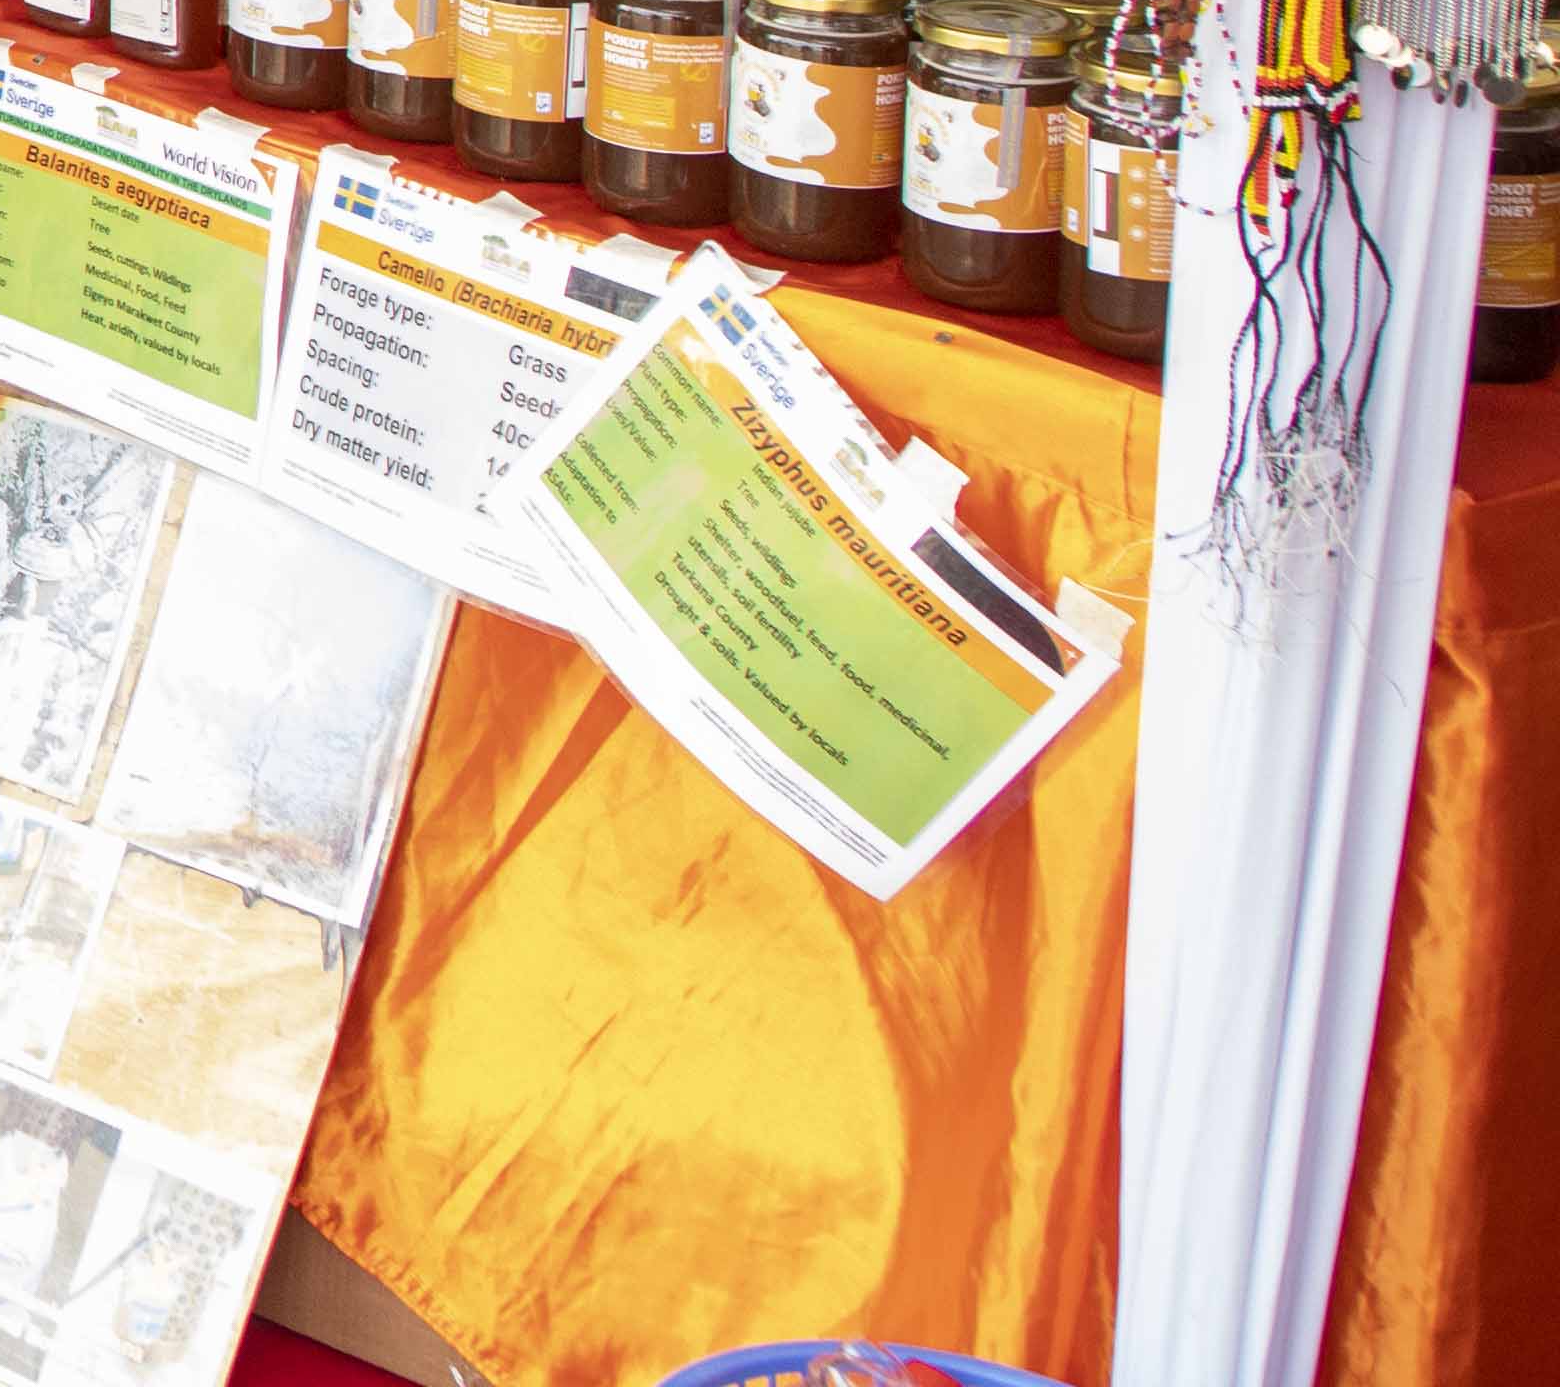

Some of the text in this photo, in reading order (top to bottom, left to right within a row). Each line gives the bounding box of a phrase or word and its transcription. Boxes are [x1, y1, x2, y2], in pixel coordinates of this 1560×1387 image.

[5, 87, 55, 118] Sverige
[25, 144, 212, 229] Balanites aegyptiaca
[163, 142, 259, 193] World Vision
[1488, 182, 1534, 197] OKOT
[88, 218, 111, 236] Tree
[377, 208, 435, 244] Sverige
[1487, 204, 1537, 219] ONEY
[163, 295, 187, 315] Feed
[320, 267, 567, 383] Forage type: Grass
[377, 250, 616, 358] Camello (Brachiaria hybri
[142, 334, 175, 358] valued
[175, 347, 190, 365] by
[191, 354, 222, 376] locals
[164, 320, 201, 345] County
[312, 302, 431, 369] Propagation:
[306, 338, 380, 388] Spacing:
[740, 342, 796, 410] Sverige
[299, 375, 426, 447] Crude protein:
[292, 409, 321, 442] Dry
[326, 427, 381, 466] matter
[383, 451, 435, 493] yield:
[736, 477, 761, 510] Tree
[730, 397, 970, 647] Zizyphus mauritiana
[713, 603, 761, 652] County
[838, 662, 875, 700] food,
[789, 710, 809, 732] by
